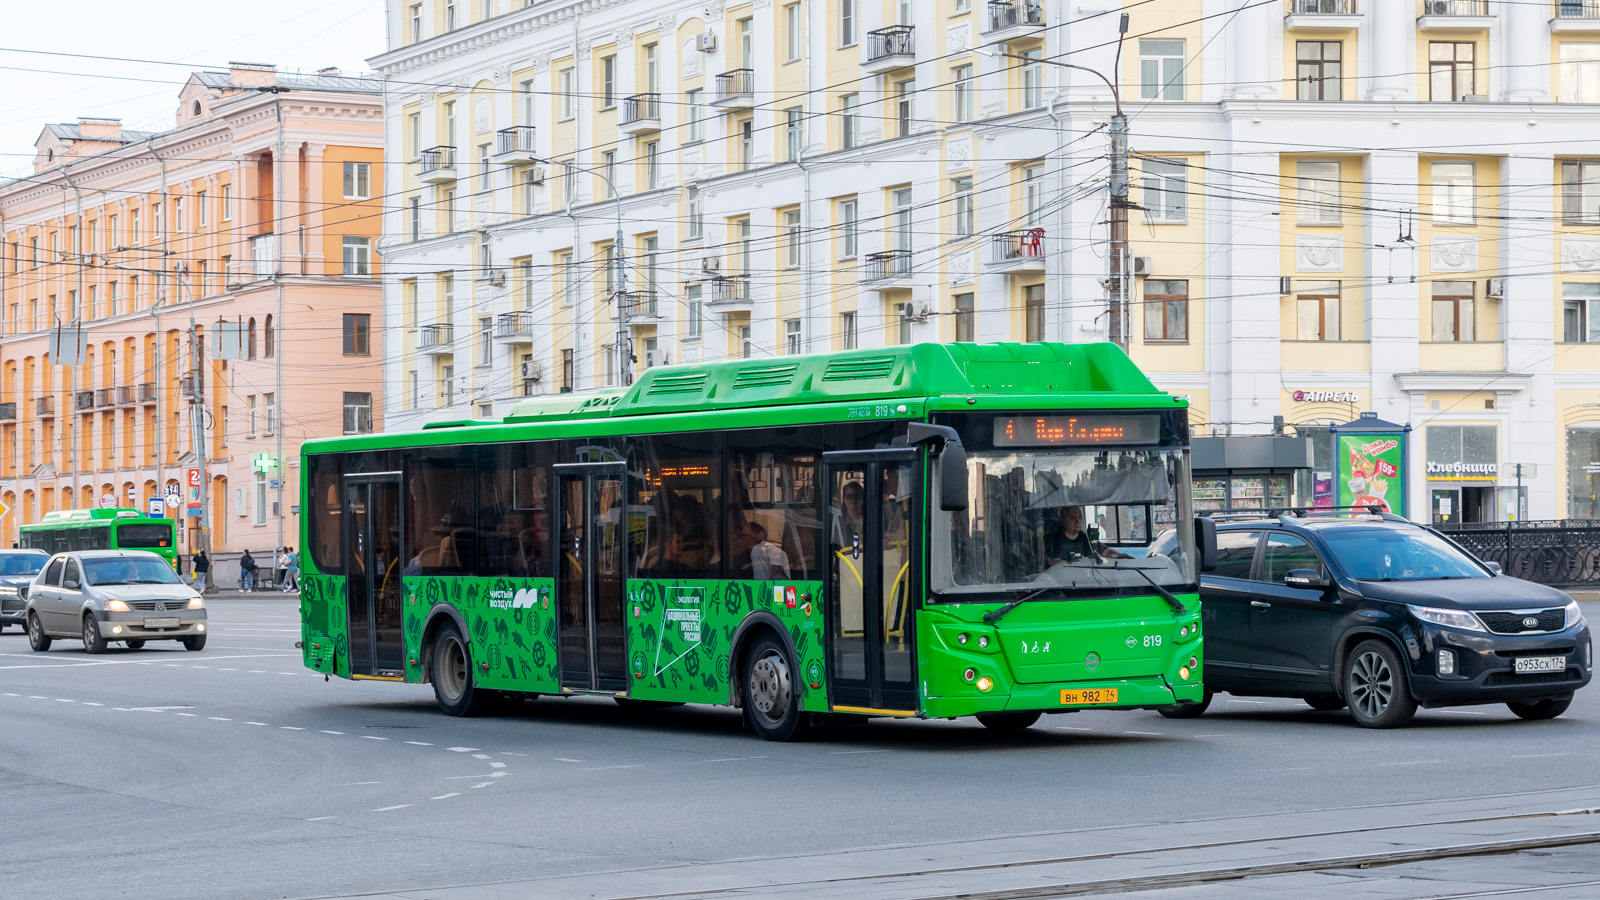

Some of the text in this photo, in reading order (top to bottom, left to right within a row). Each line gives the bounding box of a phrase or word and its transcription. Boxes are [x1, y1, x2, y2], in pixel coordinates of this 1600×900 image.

[1306, 392, 1359, 402] АПРЕЛЬ
[876, 405, 888, 416] 819
[1362, 440, 1383, 454] Дока
[1372, 441, 1397, 456] комбо
[1426, 461, 1497, 474] Хлебница
[667, 611, 700, 620] НАЦИОНАЛЬНЫЕ
[680, 622, 700, 631] ПРОЕКТЫ
[684, 632, 700, 641] РОССИИ
[1143, 634, 1162, 647] 819
[1517, 658, 1564, 670] О953СХ 174
[1066, 690, 1114, 702] ВН 982 74
